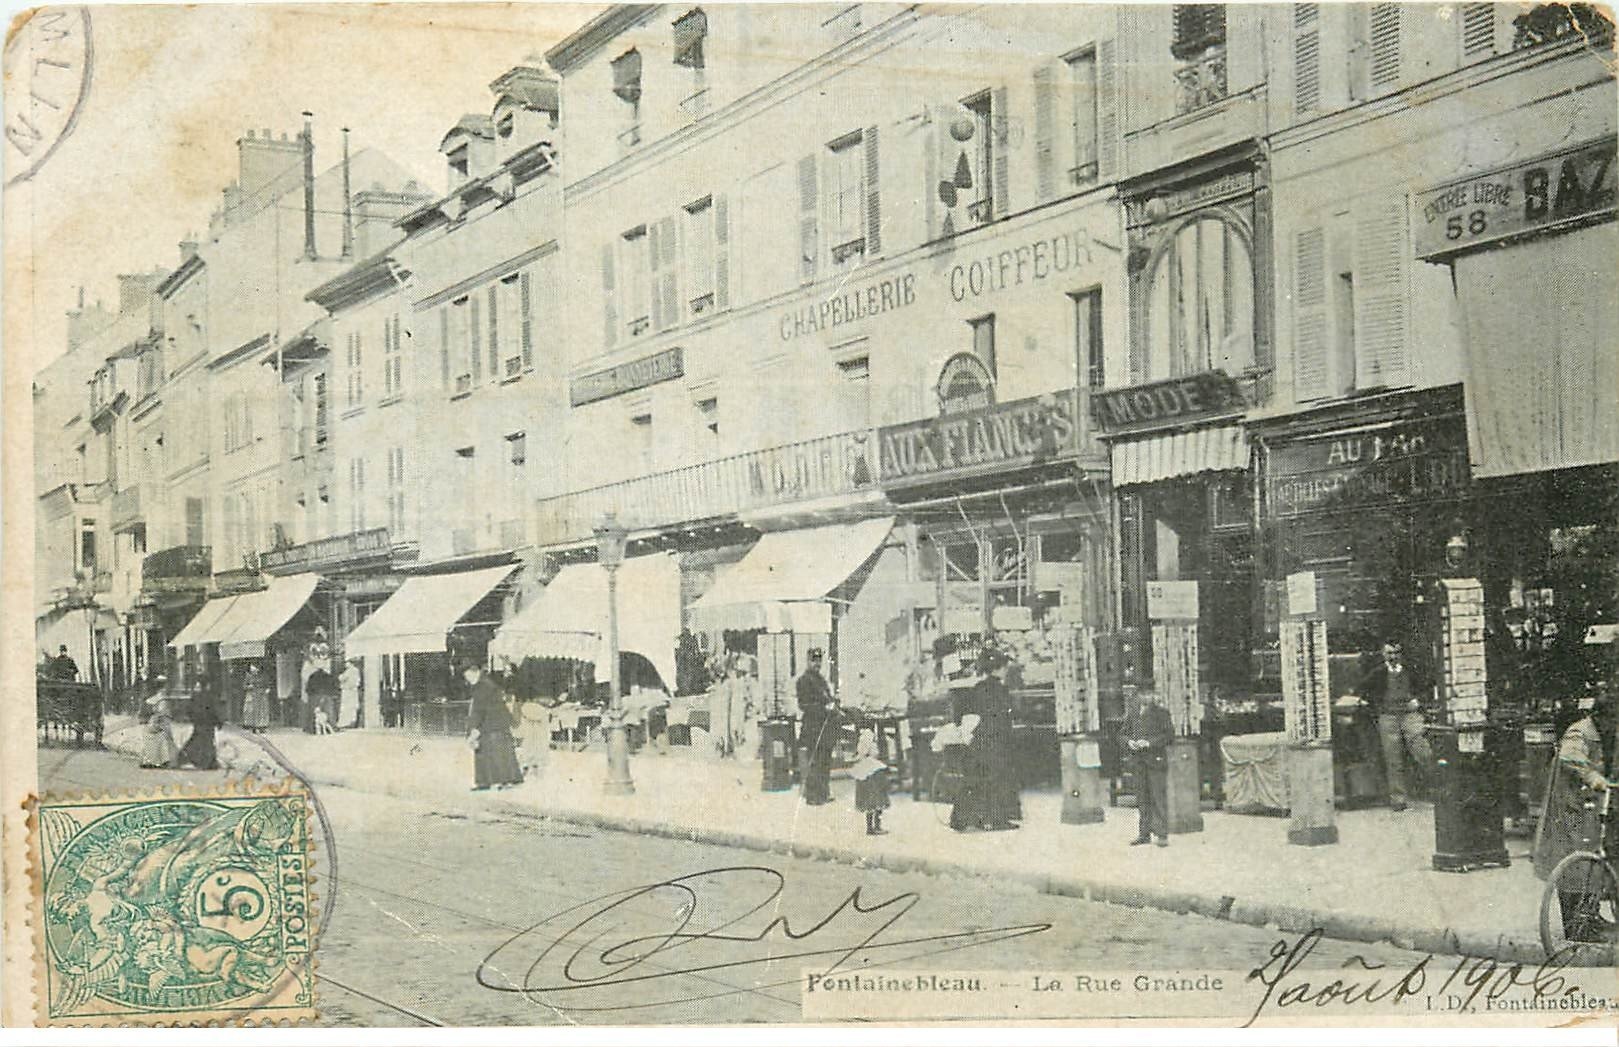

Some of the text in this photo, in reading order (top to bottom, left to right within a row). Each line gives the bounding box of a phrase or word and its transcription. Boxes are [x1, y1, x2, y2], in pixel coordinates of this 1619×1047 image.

[1474, 182, 1514, 208] LIBRE
[1446, 210, 1487, 241] 58
[780, 228, 1093, 341] CHAPELLERIE COIFFEUR
[880, 410, 1073, 476] AUX FIANCS
[1328, 440, 1362, 465] AU
[281, 859, 307, 948] POSTES
